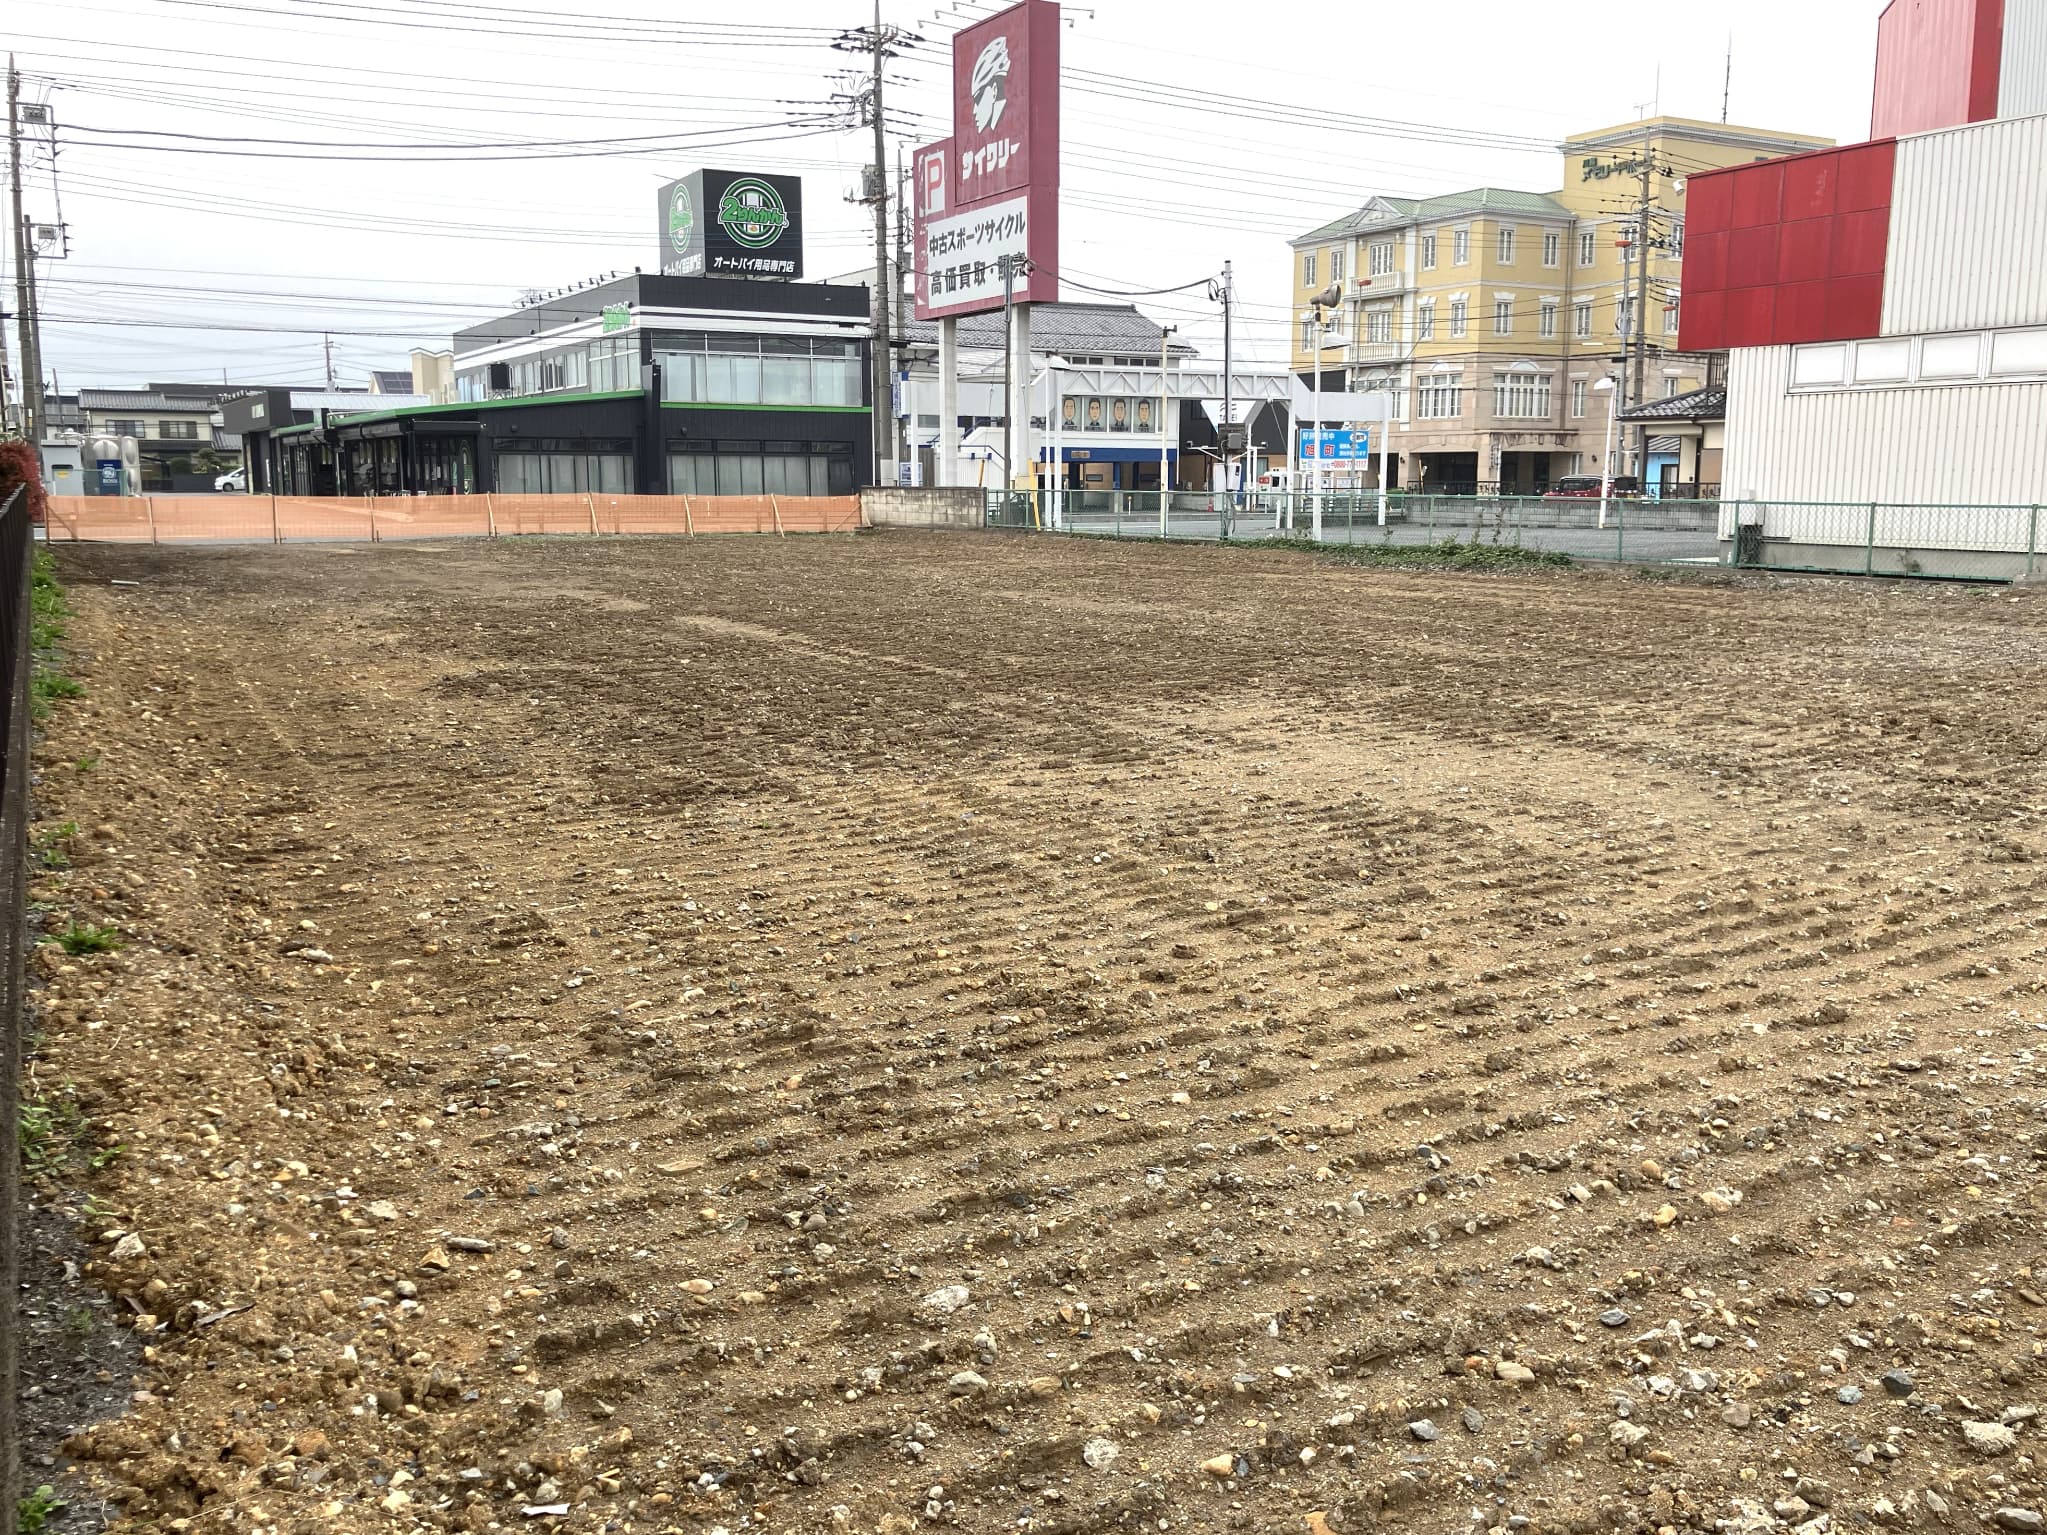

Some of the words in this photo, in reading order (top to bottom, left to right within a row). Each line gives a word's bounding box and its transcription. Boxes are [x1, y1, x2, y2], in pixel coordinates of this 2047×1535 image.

[927, 157, 943, 209] P
[929, 211, 1026, 257] 中古スポーツサイクル
[713, 256, 796, 273] オートバイ用品専門店
